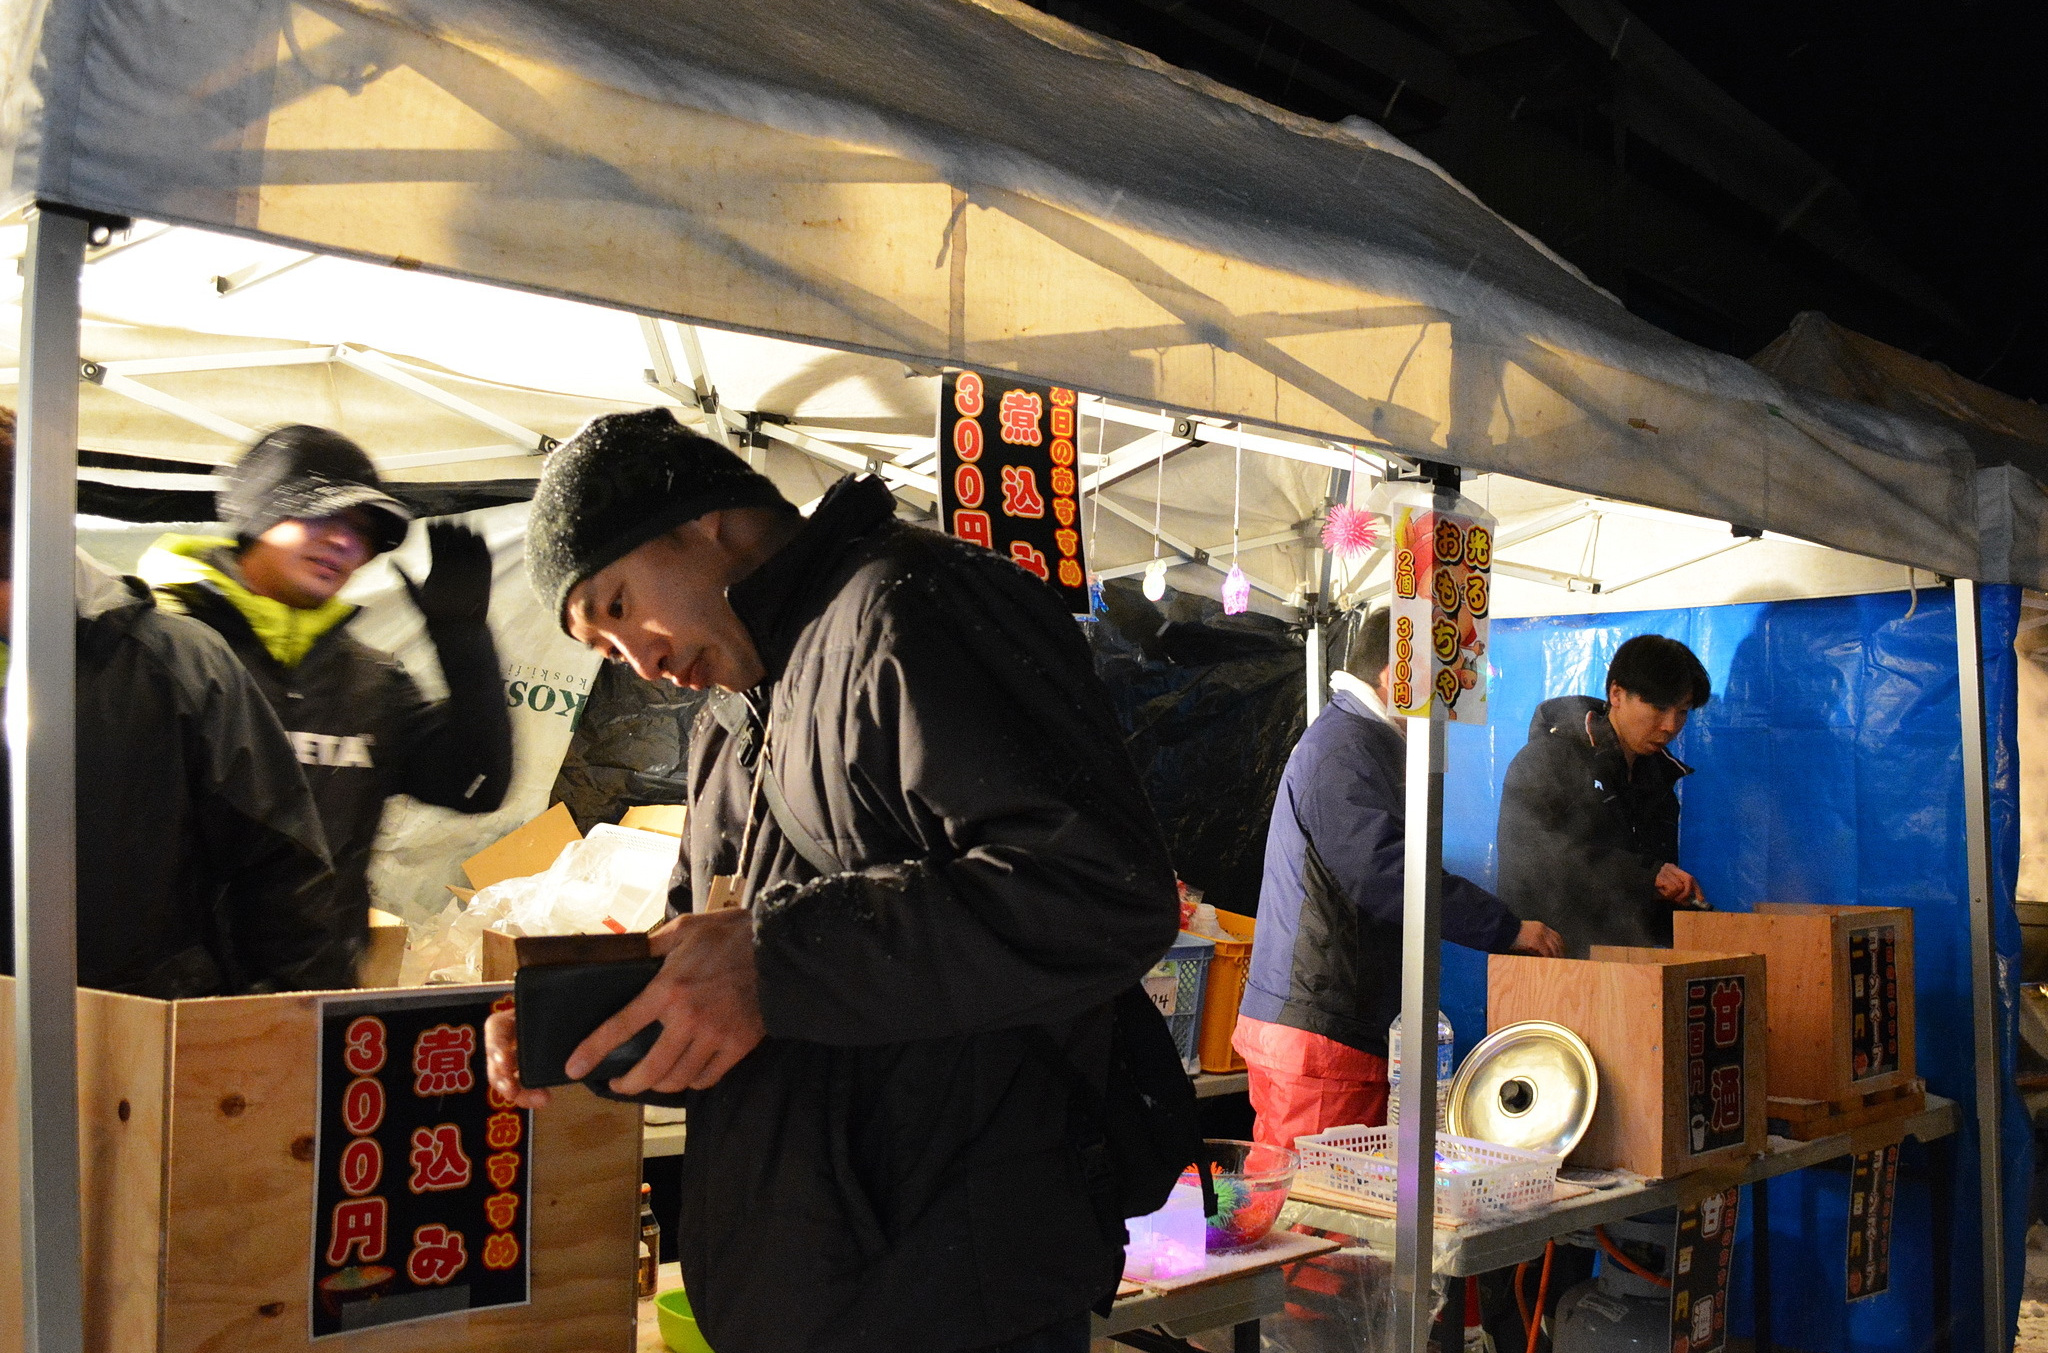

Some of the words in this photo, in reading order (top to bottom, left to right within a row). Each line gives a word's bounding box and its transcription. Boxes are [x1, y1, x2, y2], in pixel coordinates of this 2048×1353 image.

[954, 370, 993, 549] 300円
[1396, 549, 1415, 598] 2個
[1432, 518, 1463, 704] おもちゃ
[1464, 524, 1492, 616] 光る
[507, 663, 587, 691] koski.fi
[1393, 616, 1413, 708] 300円
[1689, 985, 1706, 1096] 二百円
[1710, 980, 1743, 1132] 甘酒
[325, 1015, 389, 1267] 300円
[407, 1023, 477, 1286] 煮込み
[1690, 1192, 1725, 1348] 甘酒
